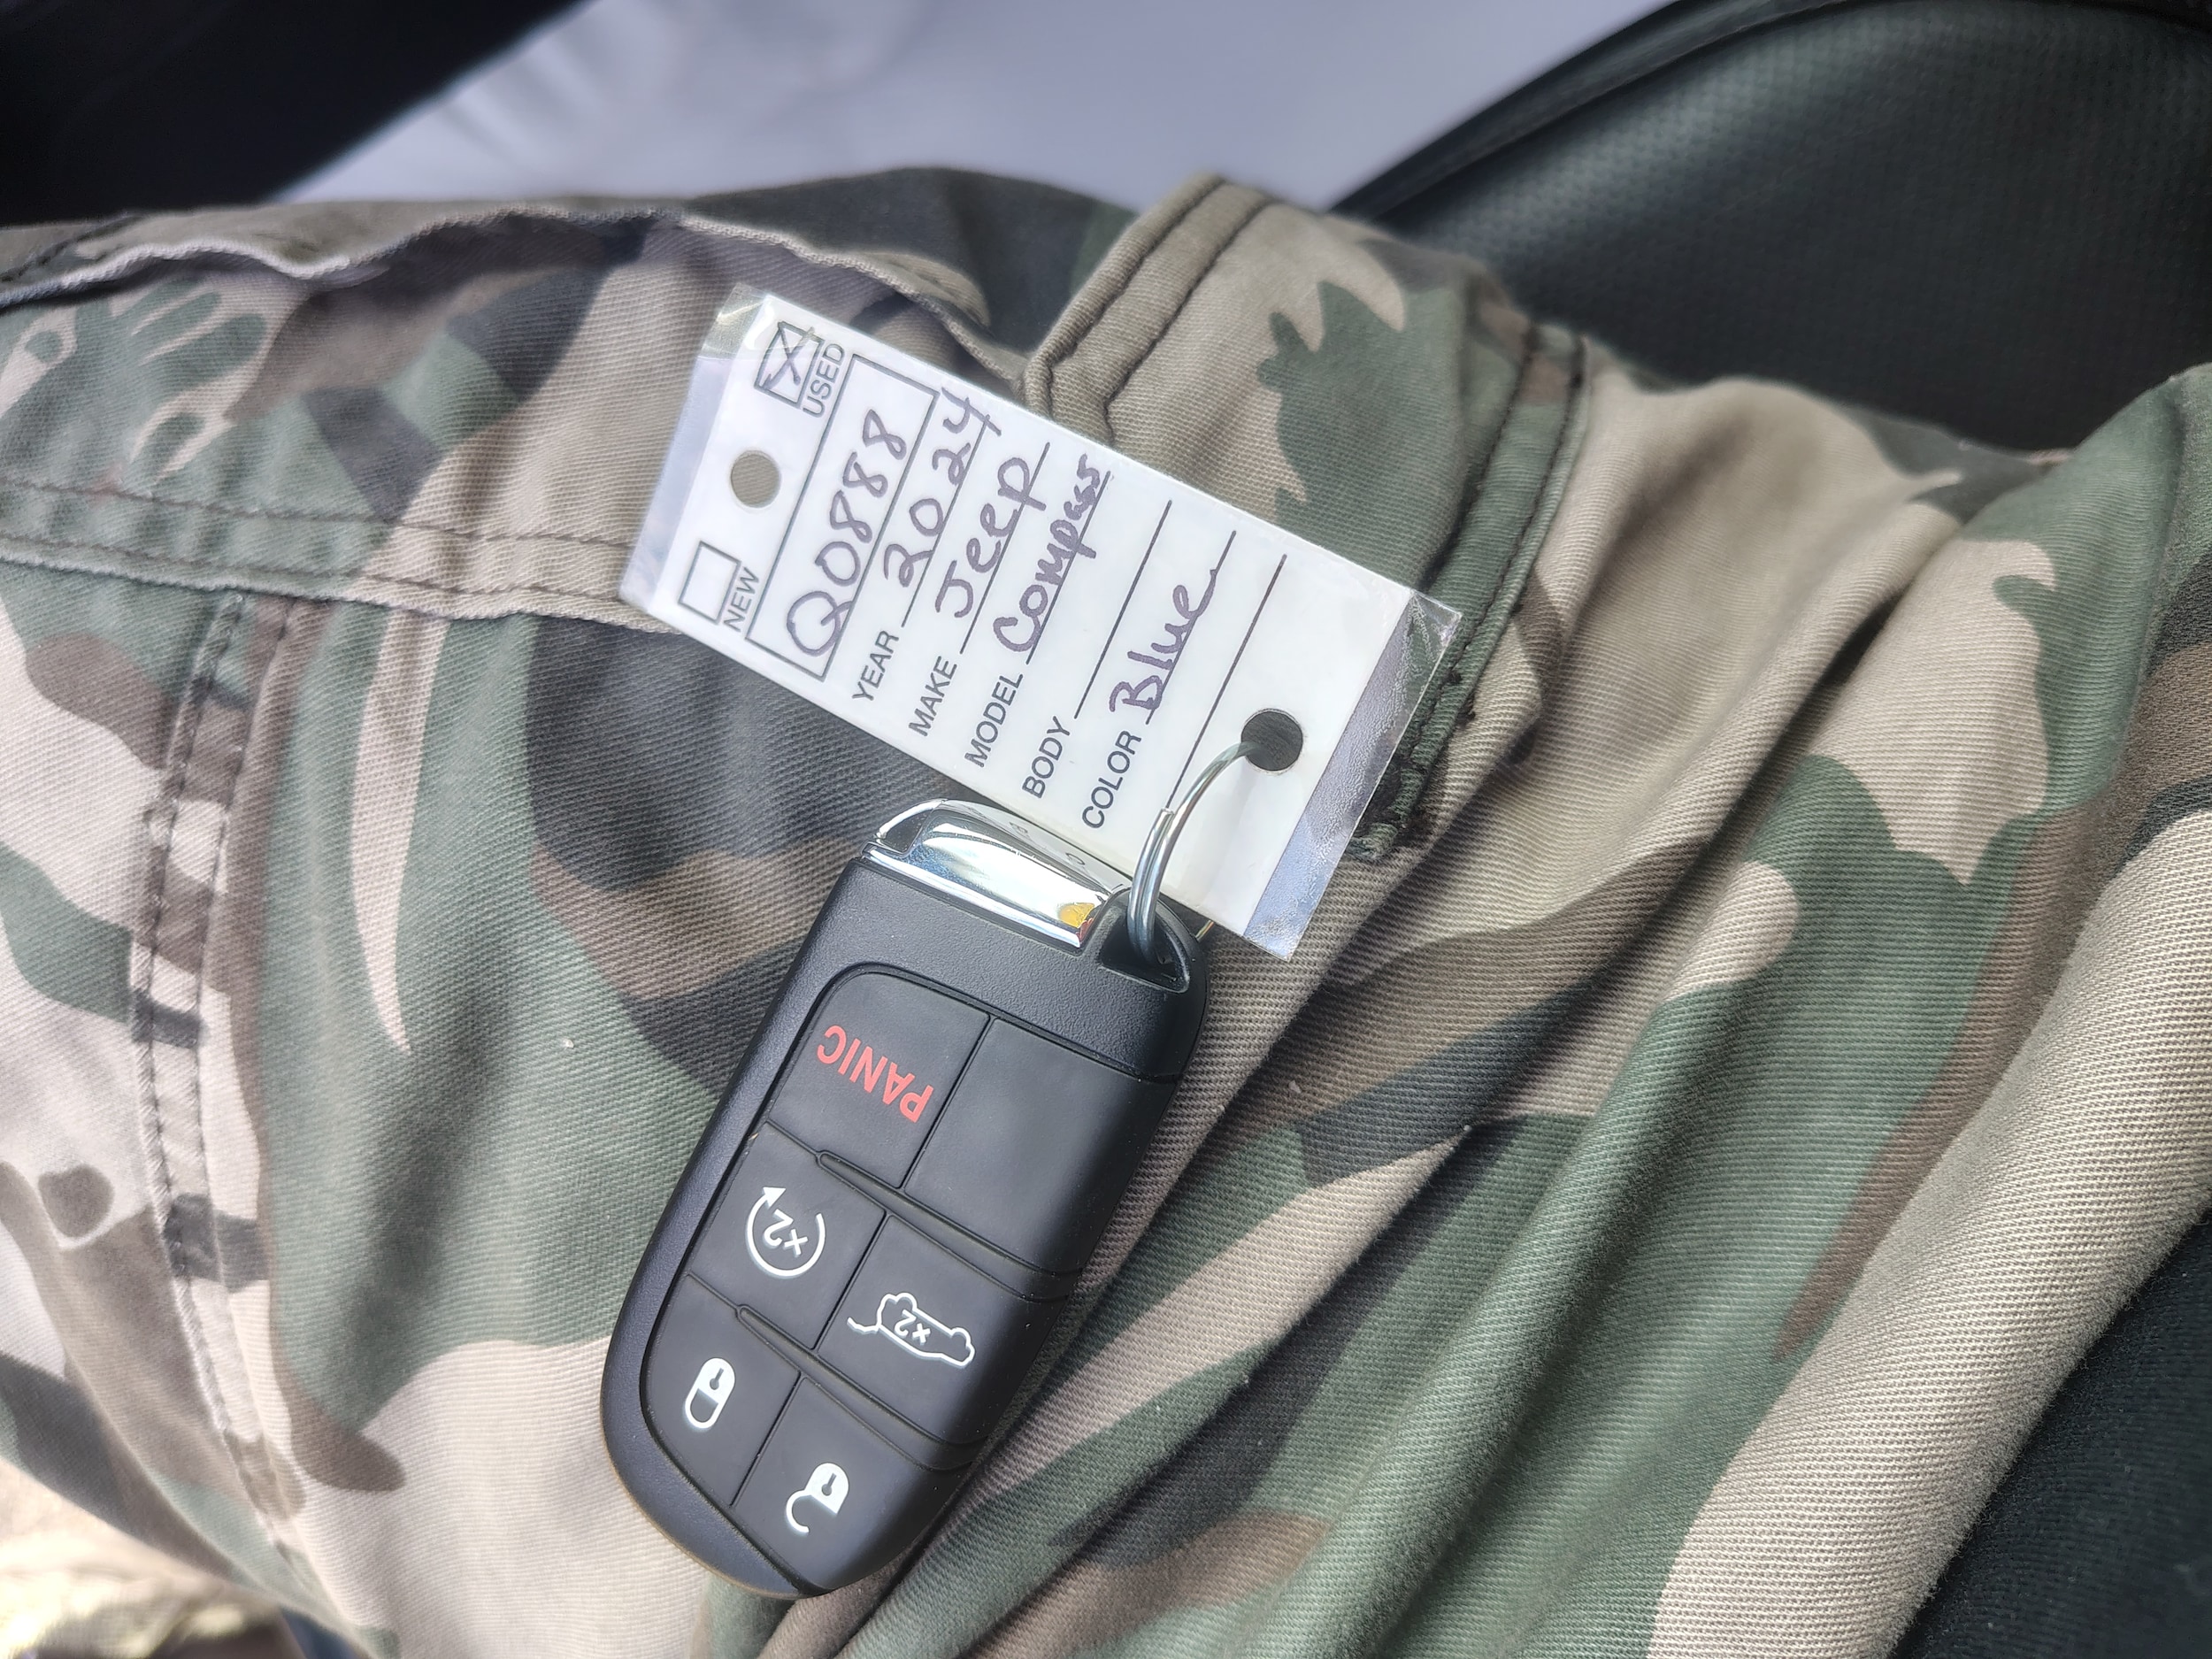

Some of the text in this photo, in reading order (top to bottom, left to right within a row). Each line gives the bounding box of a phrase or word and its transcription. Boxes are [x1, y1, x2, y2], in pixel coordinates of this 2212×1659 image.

[803, 343, 845, 419] USED
[723, 567, 761, 633] NEW
[787, 410, 907, 657] Q0888
[853, 387, 1001, 701] YEAR 2024
[909, 457, 1047, 736] MAKE Jeep
[965, 454, 1099, 768] MODEL Compass
[1022, 716, 1071, 799] BODY
[1082, 568, 1218, 829] COLOR Blue
[817, 1025, 934, 1123] PANIC
